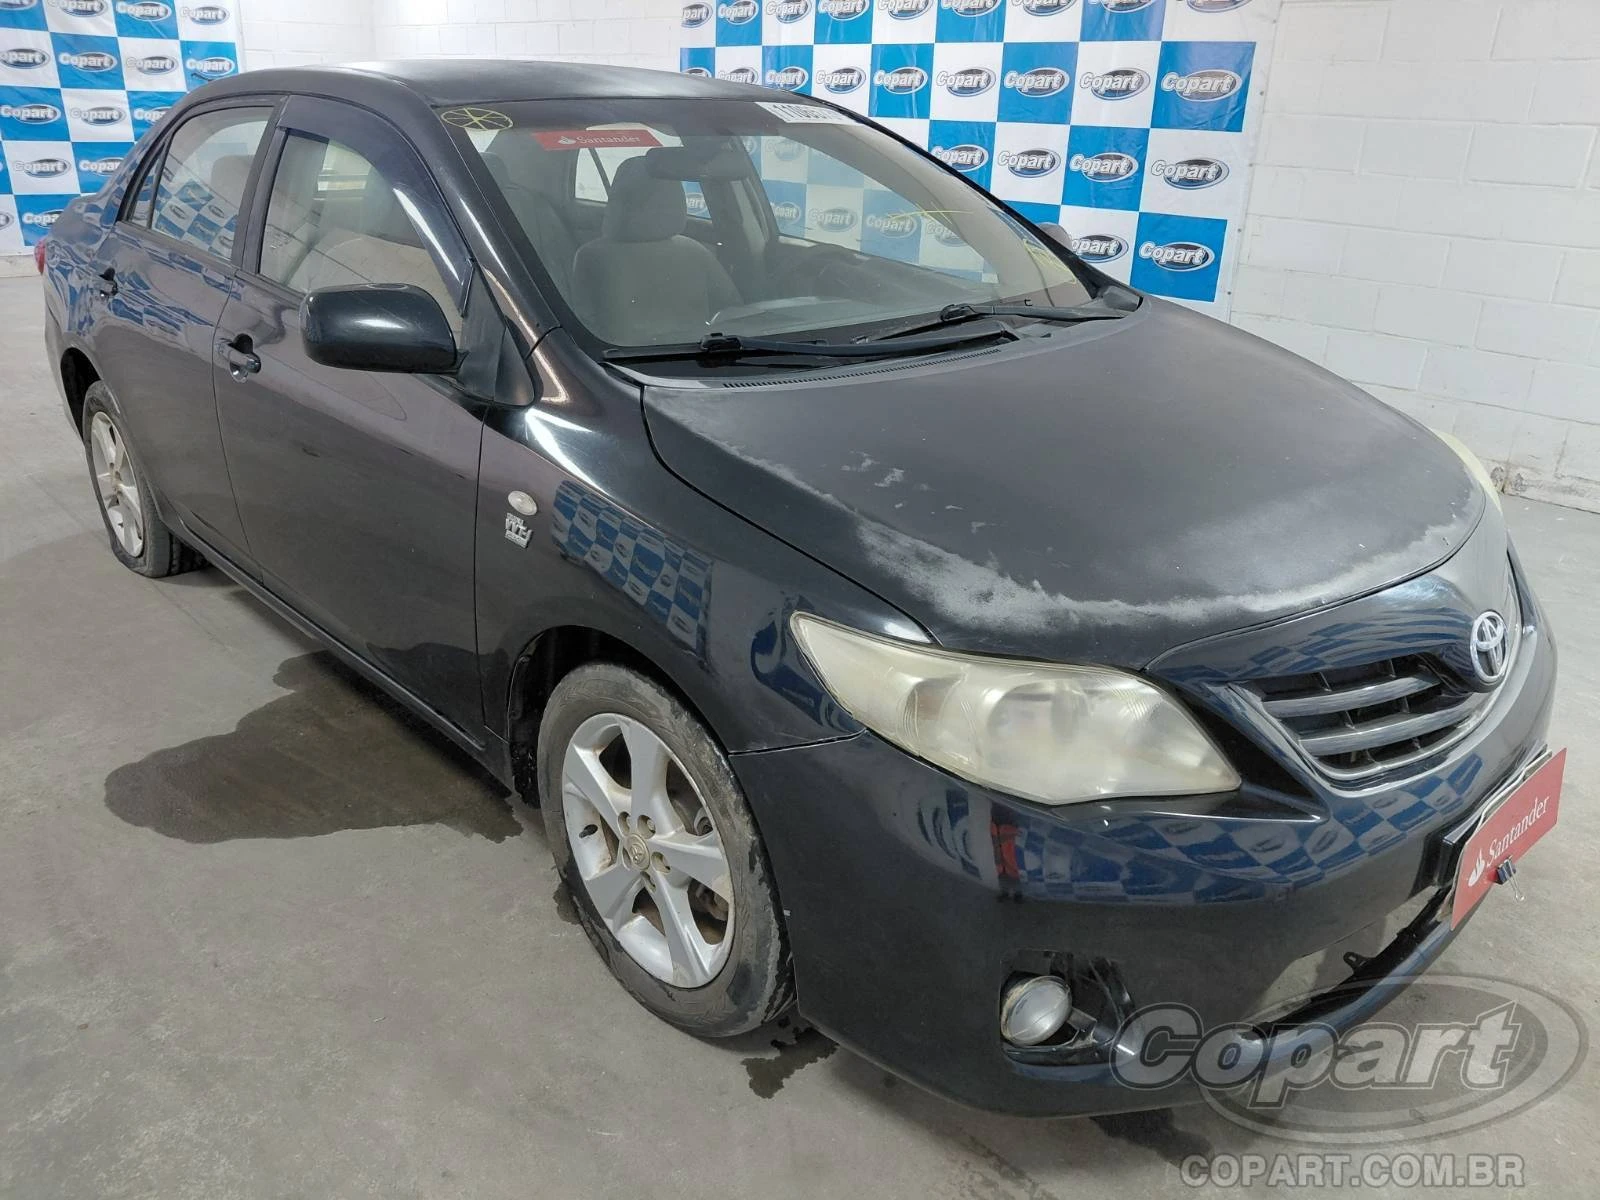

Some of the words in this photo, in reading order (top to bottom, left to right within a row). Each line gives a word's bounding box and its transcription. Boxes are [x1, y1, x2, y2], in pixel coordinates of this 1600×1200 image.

[116, 2, 167, 18] Copart
[181, 6, 225, 21] Copart
[682, 3, 709, 20] part
[718, 2, 755, 21] Copart
[766, 0, 805, 18] Copart
[817, 0, 863, 16] Copart
[0, 51, 43, 65] opart
[59, 52, 111, 69] Copart
[126, 57, 173, 71] Copart
[186, 58, 231, 73] Copart
[767, 69, 802, 88] Copart
[815, 69, 859, 87] Copart
[873, 69, 923, 88] Copart
[936, 70, 990, 89] Copart
[1003, 71, 1062, 90] Copart
[1080, 71, 1140, 92] Copart
[1161, 72, 1233, 95] Copart
[1, 105, 54, 121] Copart
[70, 107, 119, 122] Copart
[577, 136, 641, 144] Santander
[14, 161, 65, 175] Copart
[79, 159, 120, 174] Copar
[998, 151, 1053, 171] Copart
[1070, 154, 1130, 174] Copart
[1151, 159, 1220, 182] Copart
[808, 208, 852, 229] Copart
[866, 214, 914, 235] Copart
[1072, 237, 1119, 258] opart
[1139, 241, 1207, 265] Copart
[1486, 796, 1550, 867] Santander
